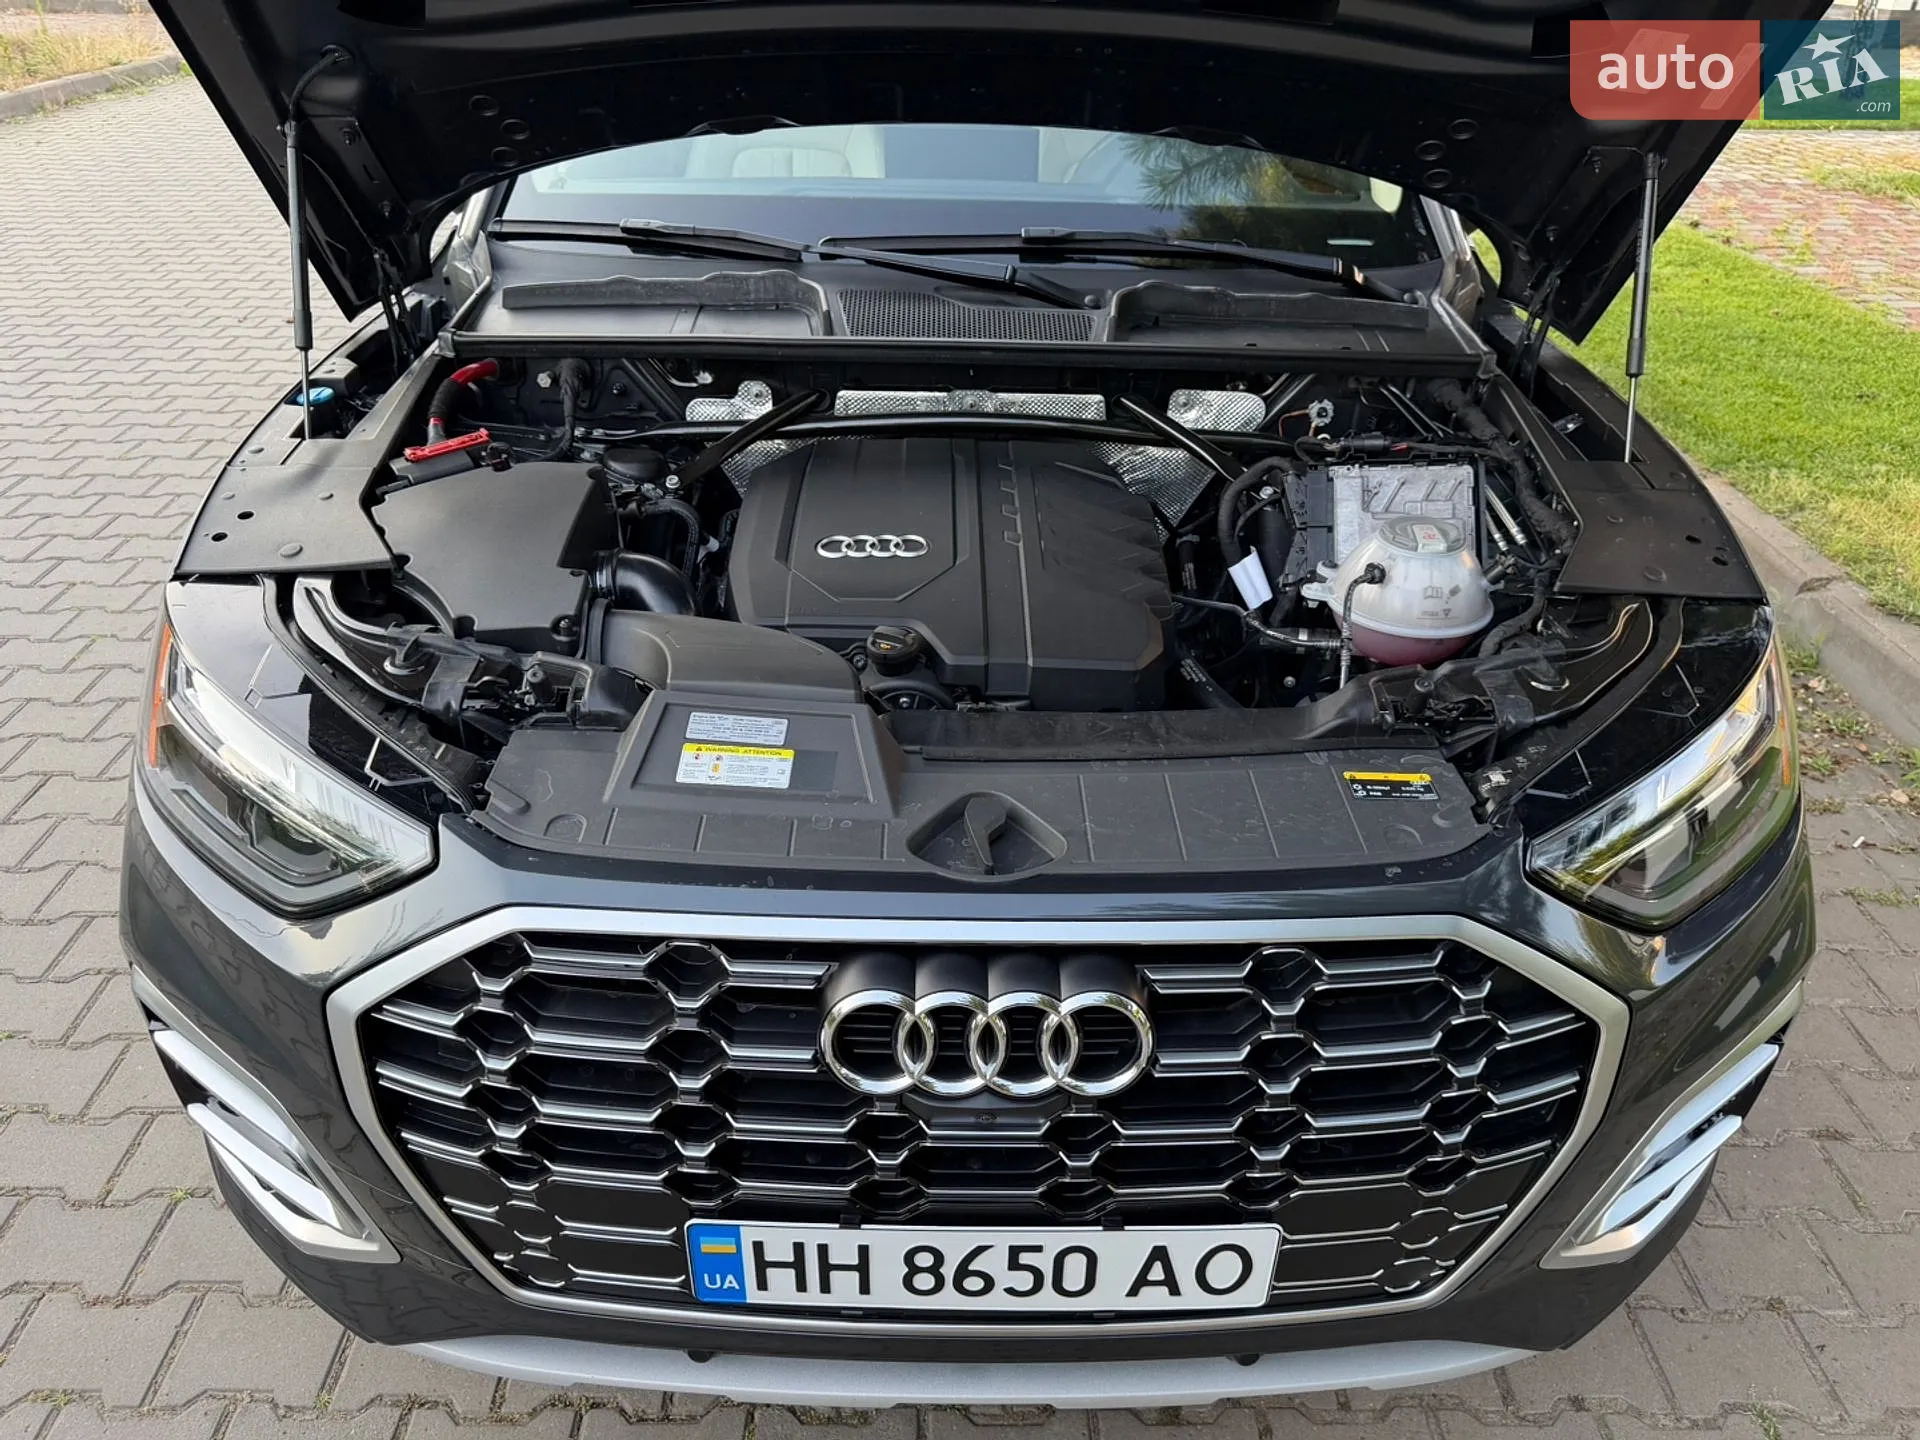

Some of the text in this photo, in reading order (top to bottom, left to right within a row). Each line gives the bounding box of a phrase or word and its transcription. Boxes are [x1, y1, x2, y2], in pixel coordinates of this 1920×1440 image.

[704, 1273, 740, 1290] UA
[751, 1240, 1254, 1298] HH 8650 AO
